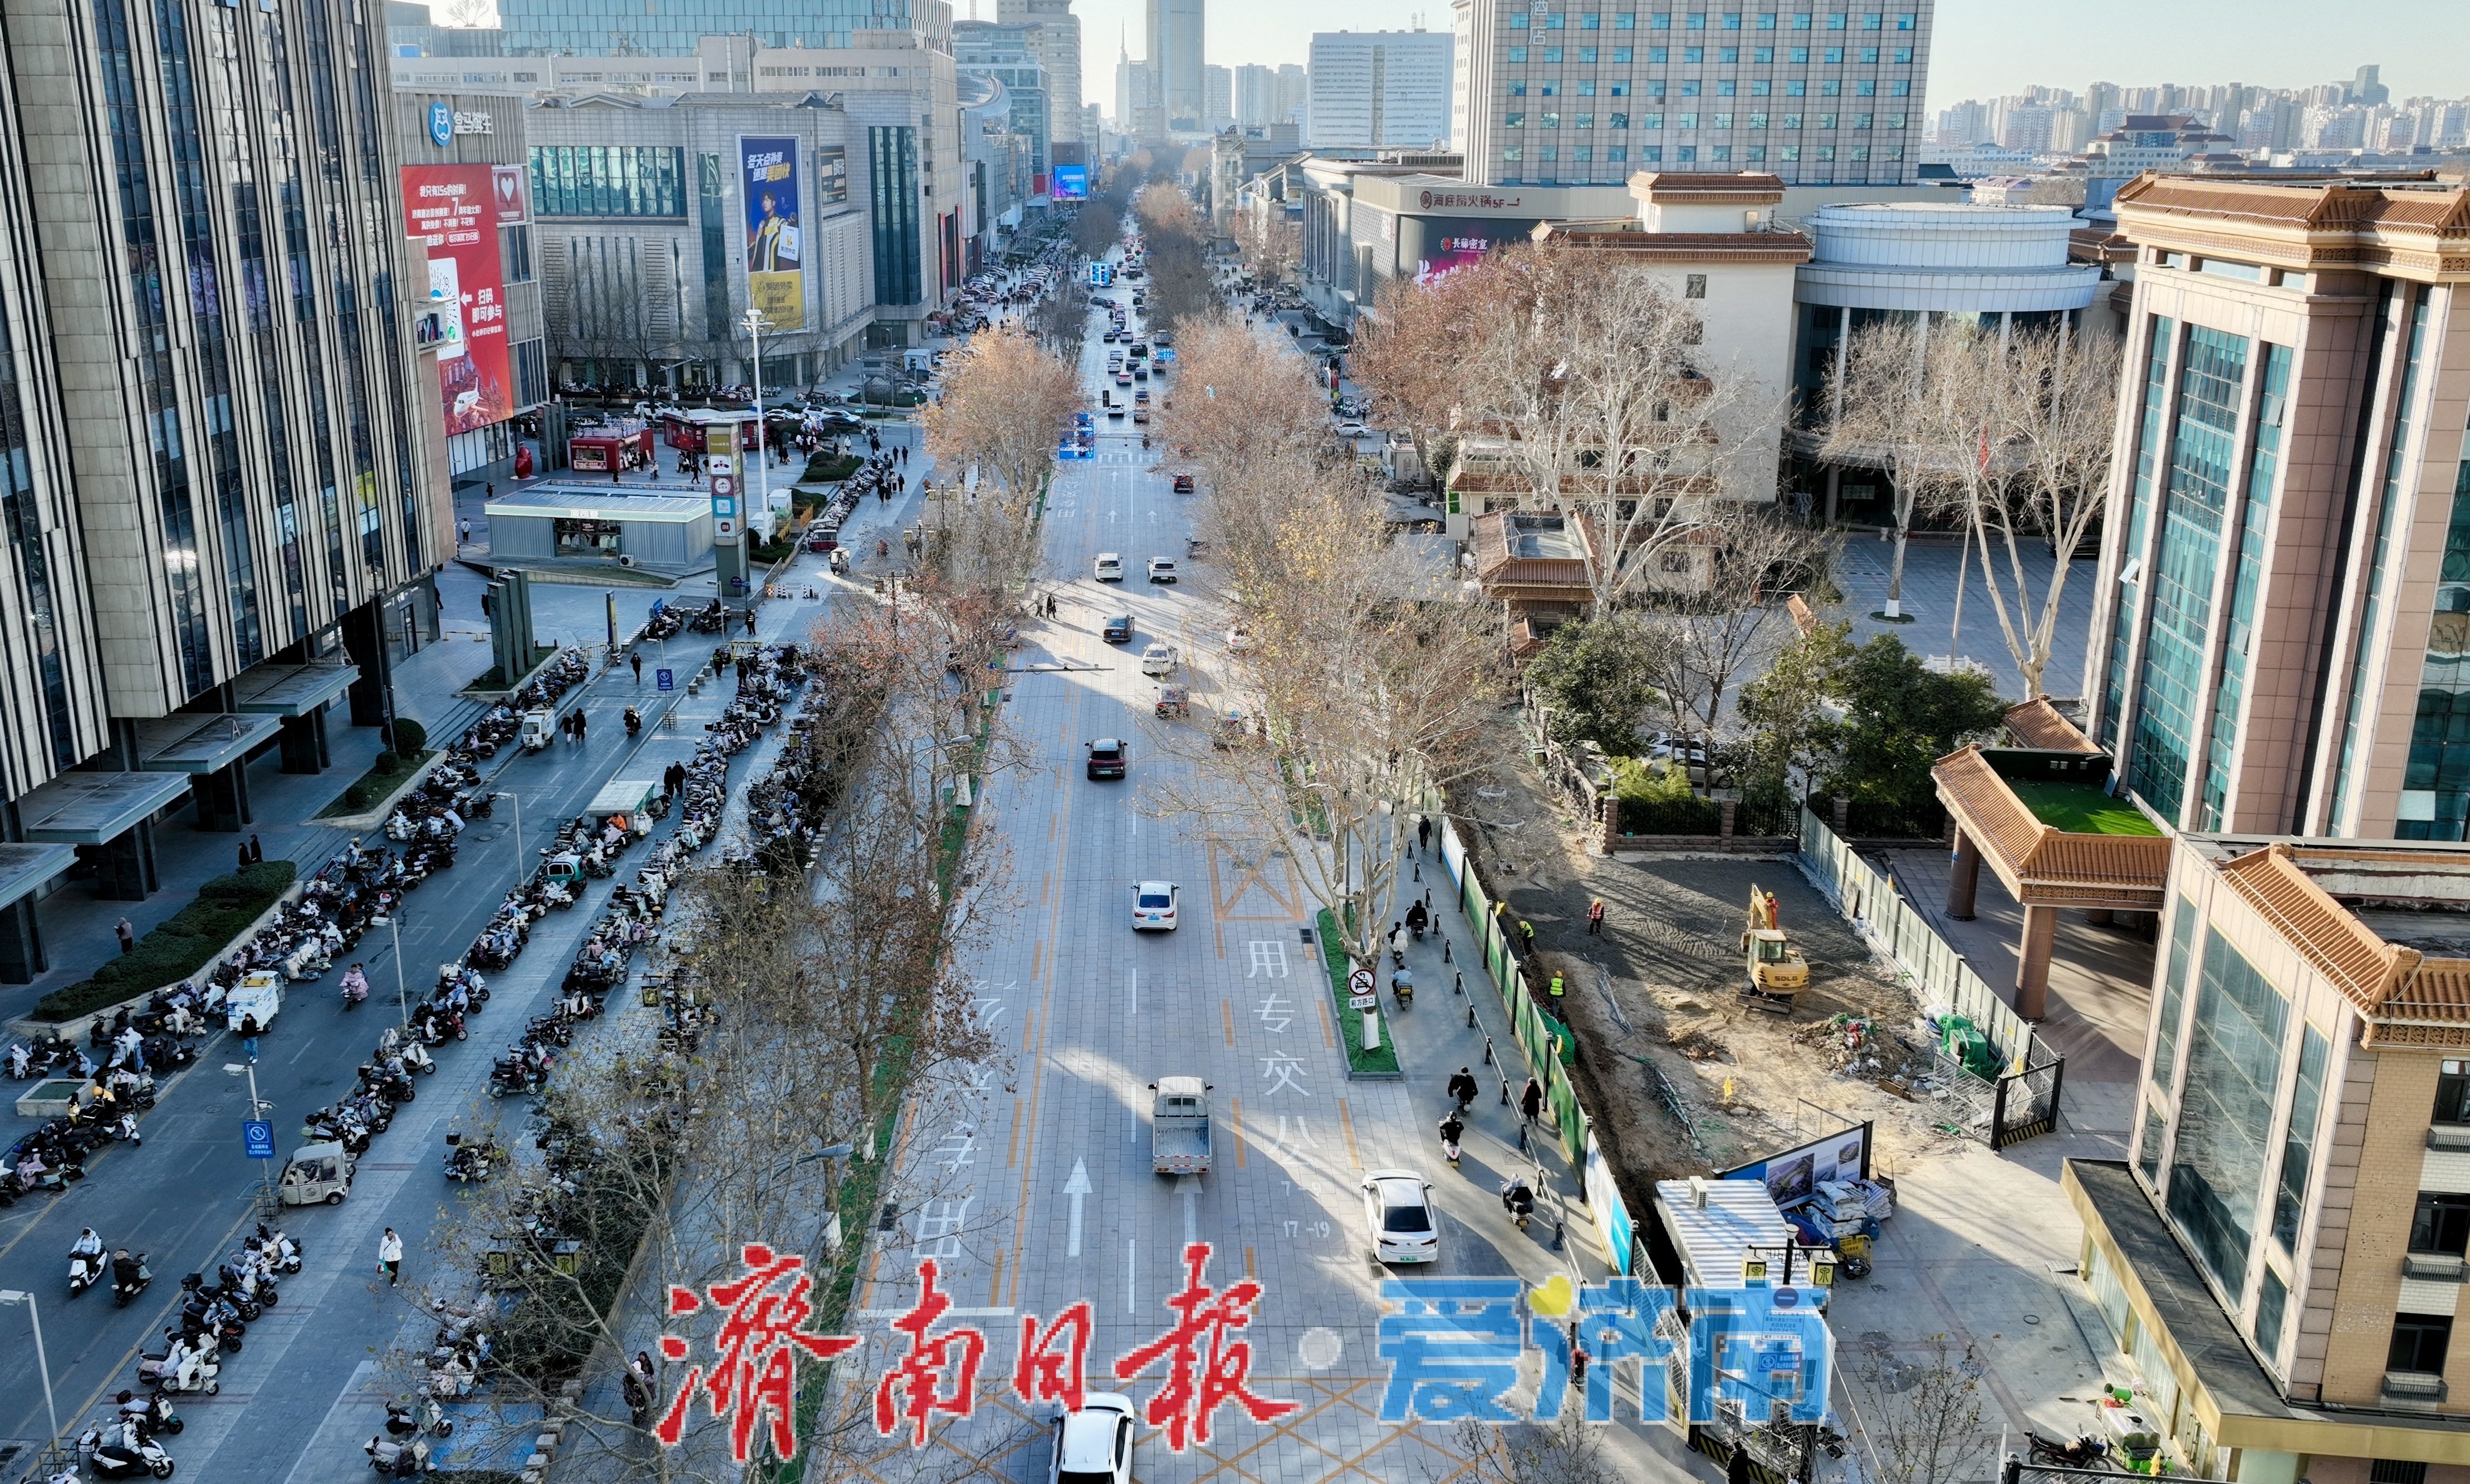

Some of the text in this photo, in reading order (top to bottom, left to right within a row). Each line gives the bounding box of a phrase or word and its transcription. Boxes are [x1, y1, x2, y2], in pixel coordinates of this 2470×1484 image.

[453, 111, 492, 134] 盒马鲜生
[1433, 194, 1504, 208] 海底捞火锅 5F
[477, 287, 493, 306] 扫码
[472, 304, 502, 324] 即可参与
[570, 509, 599, 518] 波司登
[1351, 997, 1373, 1007] 前方路口
[1283, 1220, 1330, 1239] 17-19
